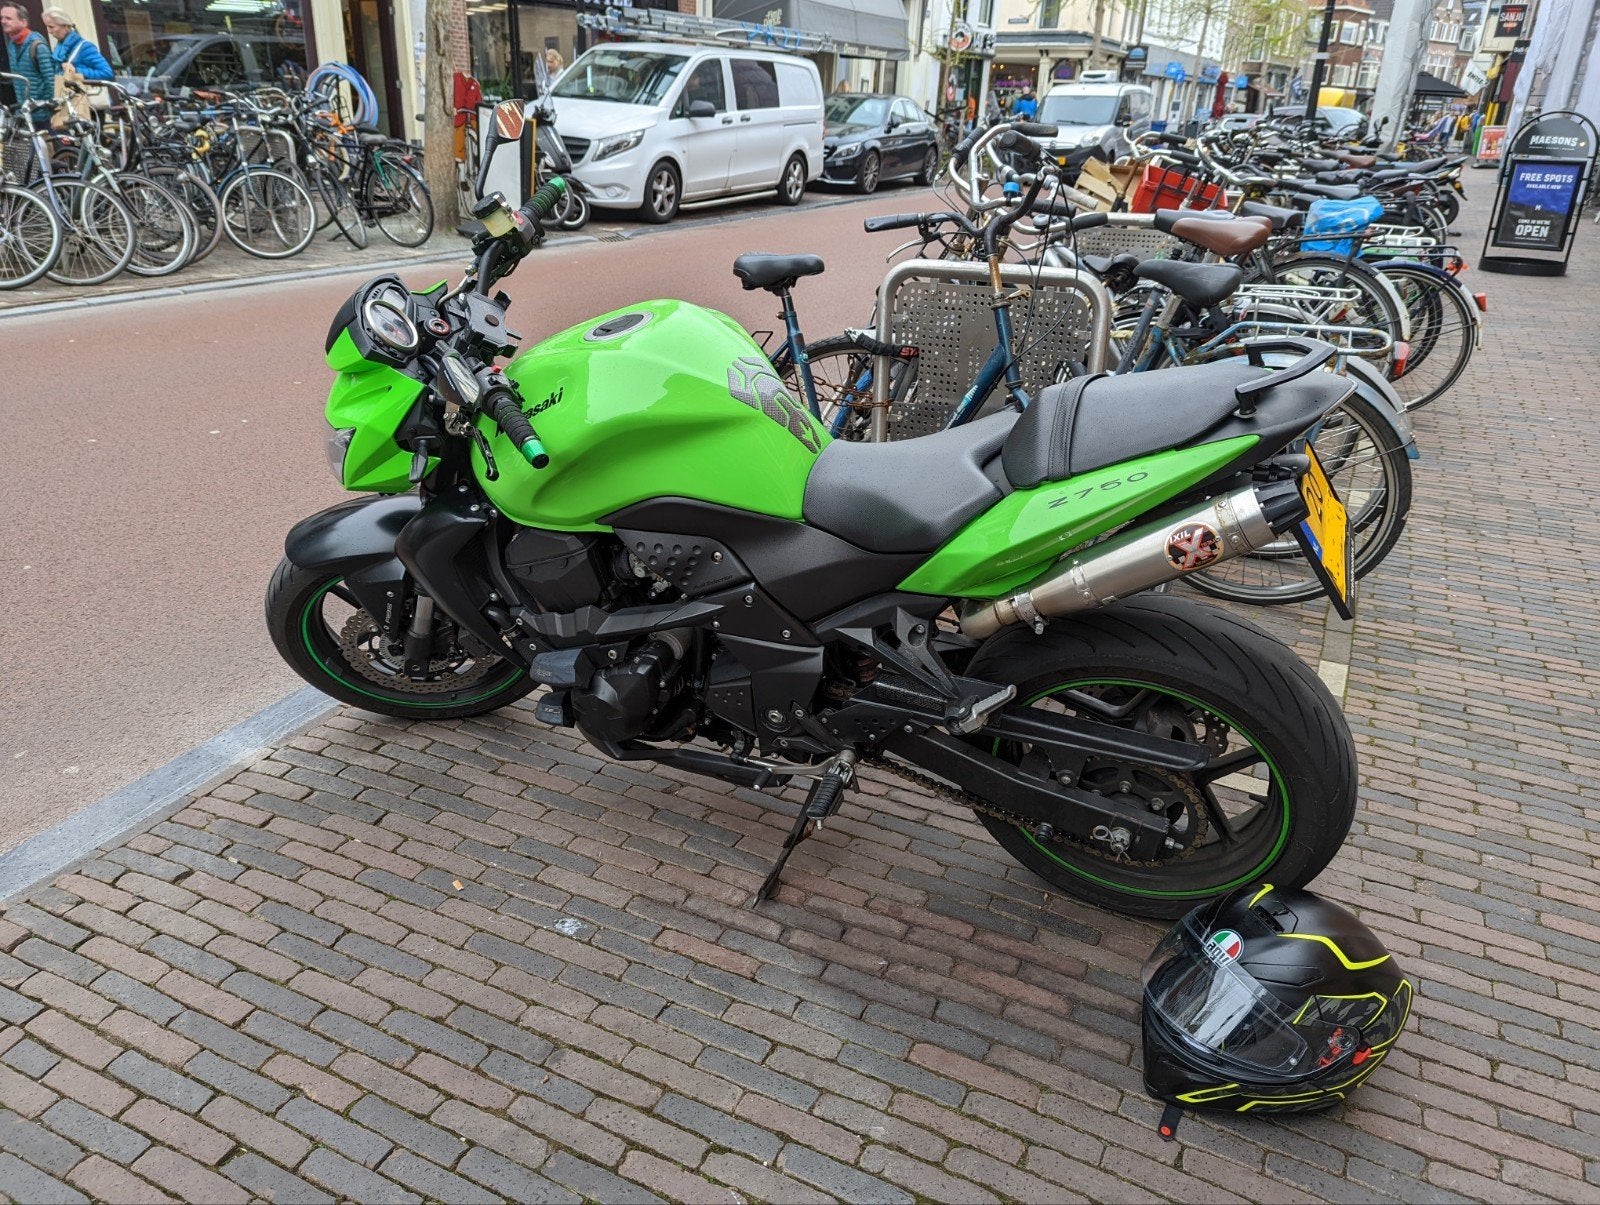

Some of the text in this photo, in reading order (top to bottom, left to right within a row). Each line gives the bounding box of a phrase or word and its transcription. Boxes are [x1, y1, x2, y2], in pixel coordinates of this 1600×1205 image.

[1529, 135, 1579, 147] MAESONS
[1519, 172, 1574, 183] FREE SPOTS
[1514, 224, 1551, 238] OPEN
[522, 387, 564, 419] asaki
[1047, 472, 1149, 509] Z750
[1168, 529, 1191, 544] IXIL
